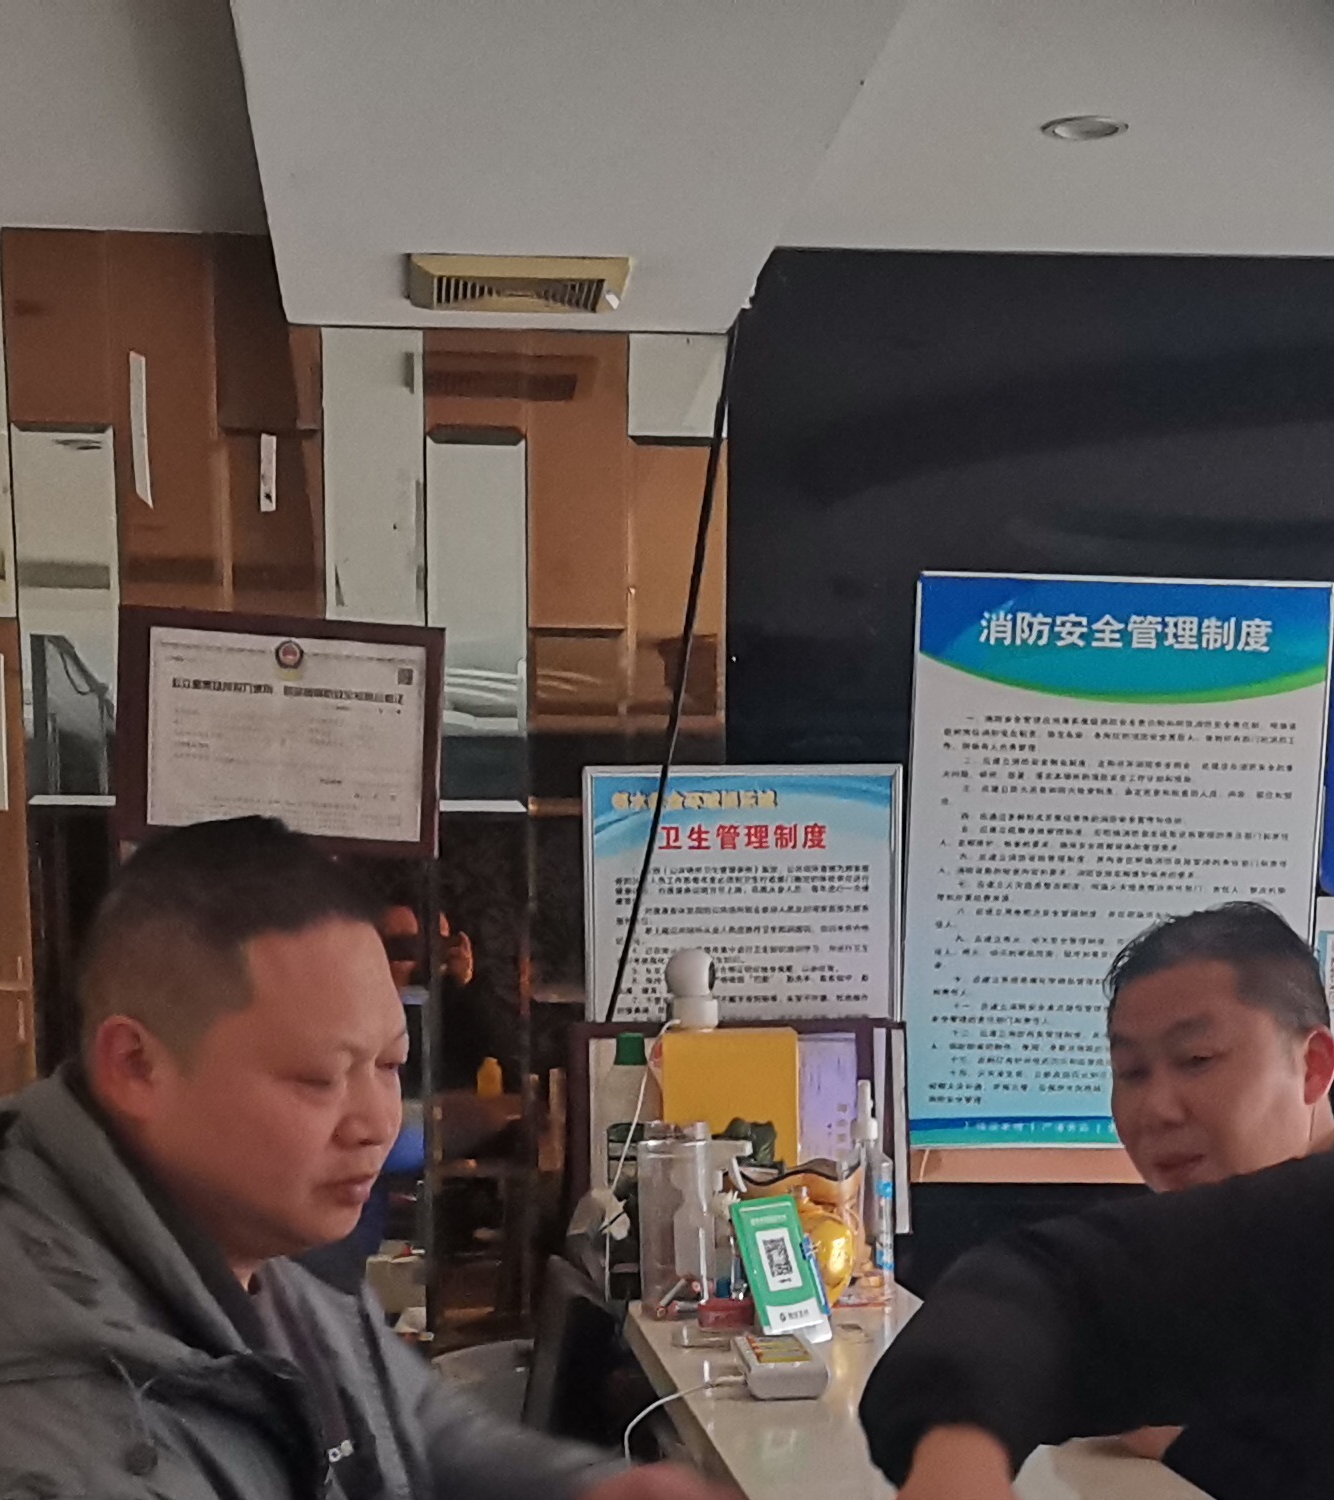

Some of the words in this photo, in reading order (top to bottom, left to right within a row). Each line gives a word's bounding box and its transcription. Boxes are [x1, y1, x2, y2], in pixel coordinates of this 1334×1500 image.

[979, 611, 1274, 653] 消防安全管理制度
[657, 822, 827, 851] 卫生管理制度
